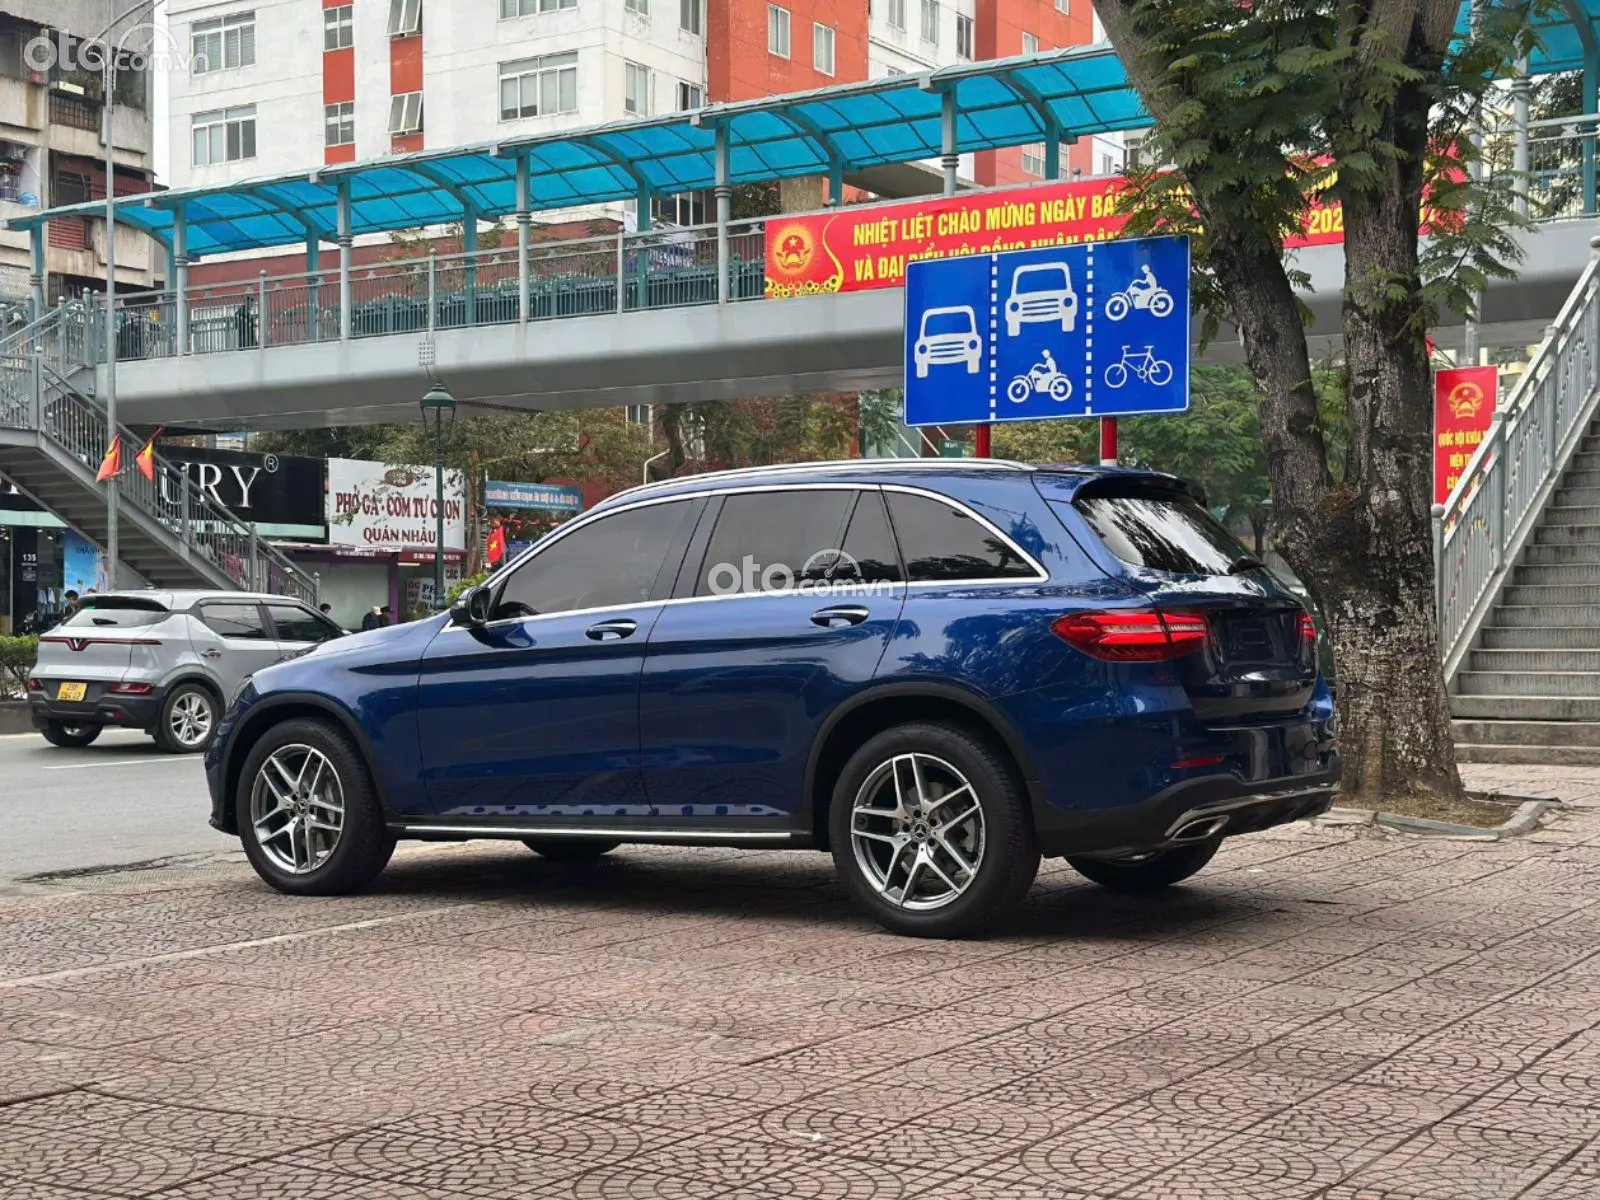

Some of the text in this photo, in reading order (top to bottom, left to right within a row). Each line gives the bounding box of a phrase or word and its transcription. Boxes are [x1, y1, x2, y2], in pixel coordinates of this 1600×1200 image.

[853, 217, 898, 248] NHIỆT
[902, 212, 934, 243] LIỆT
[938, 206, 981, 236] CHÀO
[986, 201, 1035, 231] MỪNG
[1040, 193, 1087, 224] NGÀY
[1309, 207, 1344, 234] 202
[854, 254, 904, 282] VÀ ĐẠI
[335, 484, 361, 513] PHỞ
[362, 488, 379, 516] GÀ
[414, 495, 430, 524] TỰ
[430, 498, 460, 525] CỌN
[363, 524, 436, 546] QUÁN NHẬU
